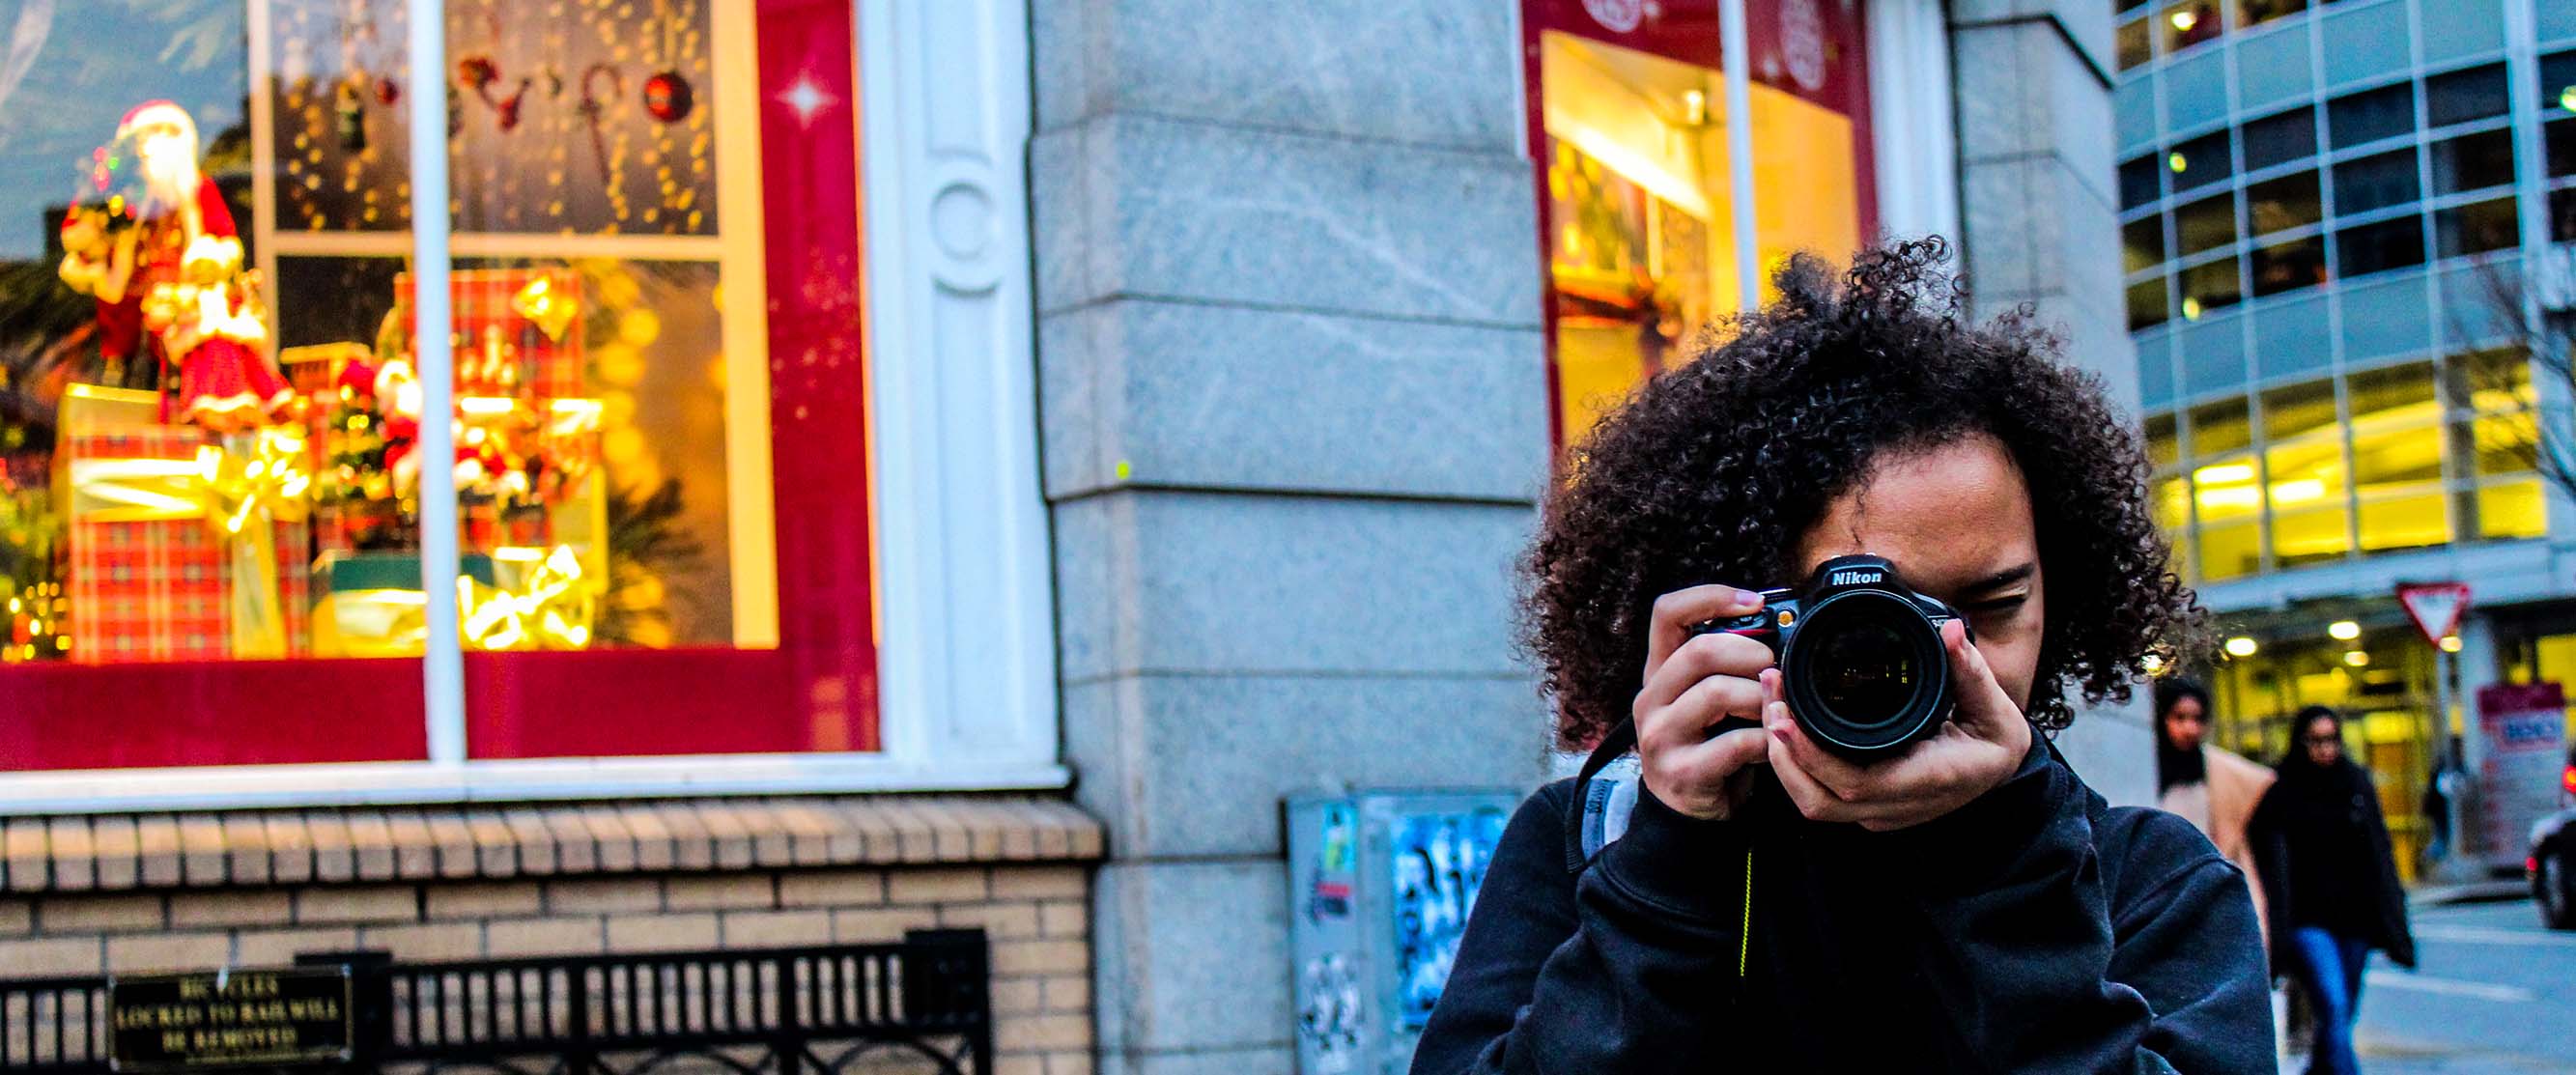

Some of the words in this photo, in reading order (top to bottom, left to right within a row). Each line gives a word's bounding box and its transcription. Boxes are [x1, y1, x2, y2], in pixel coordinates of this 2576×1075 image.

[1832, 572, 1882, 585] Nikon
[116, 1004, 203, 1030] LOCKED
[209, 1002, 237, 1024] TO
[162, 1029, 186, 1054] BE
[193, 1025, 298, 1052] REMOVED
